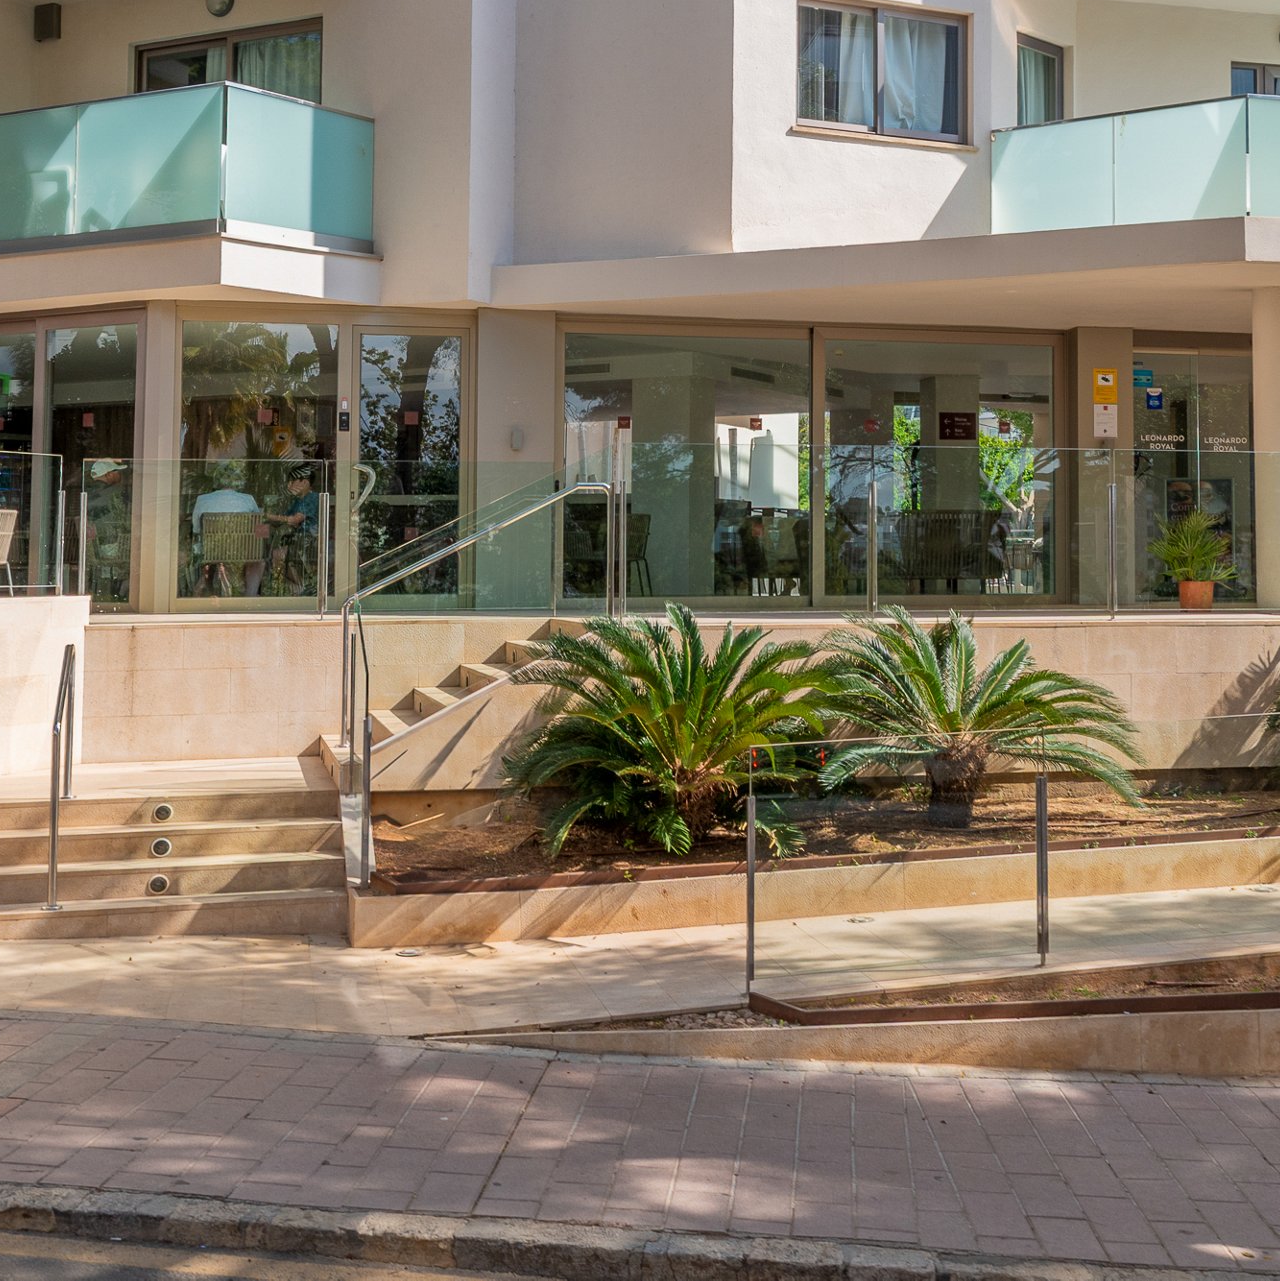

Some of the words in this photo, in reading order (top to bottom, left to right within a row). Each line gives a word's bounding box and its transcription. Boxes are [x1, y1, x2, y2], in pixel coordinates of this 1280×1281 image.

[1140, 434, 1185, 442] LEONARDO
[1204, 436, 1248, 444] LEONARDO
[1149, 442, 1176, 450] ROYAL
